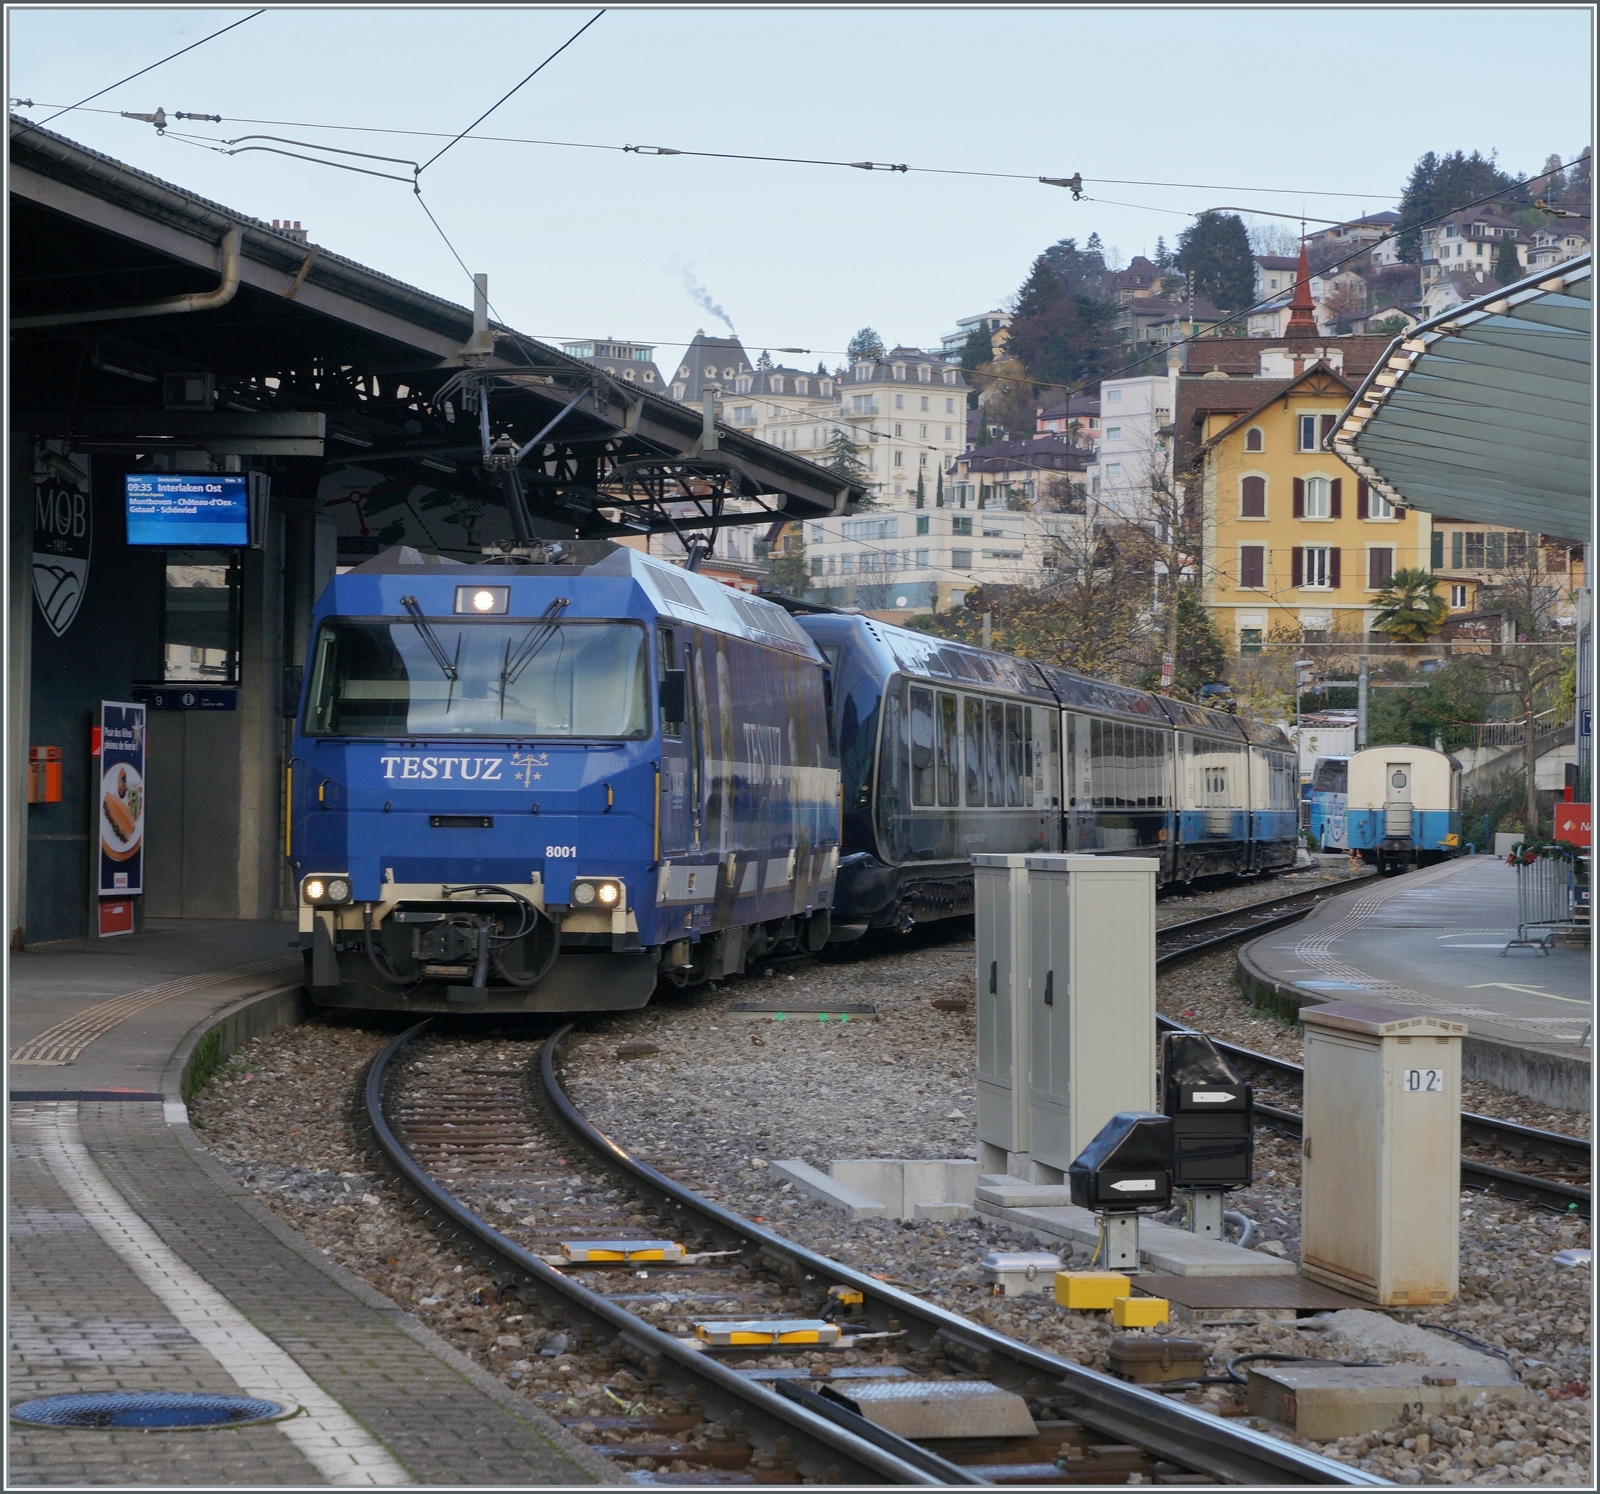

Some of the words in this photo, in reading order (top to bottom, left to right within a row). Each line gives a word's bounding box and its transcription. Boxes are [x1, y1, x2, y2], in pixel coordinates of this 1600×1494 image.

[127, 483, 153, 492] 09:35
[157, 483, 204, 492] Interlaken
[205, 484, 222, 493] Ost
[34, 486, 86, 538] MOB
[160, 506, 197, 514] Schönried
[155, 695, 163, 706] 9
[742, 722, 783, 786] TESTUZ
[380, 756, 503, 780] TESTUZ
[545, 846, 577, 858] 8001
